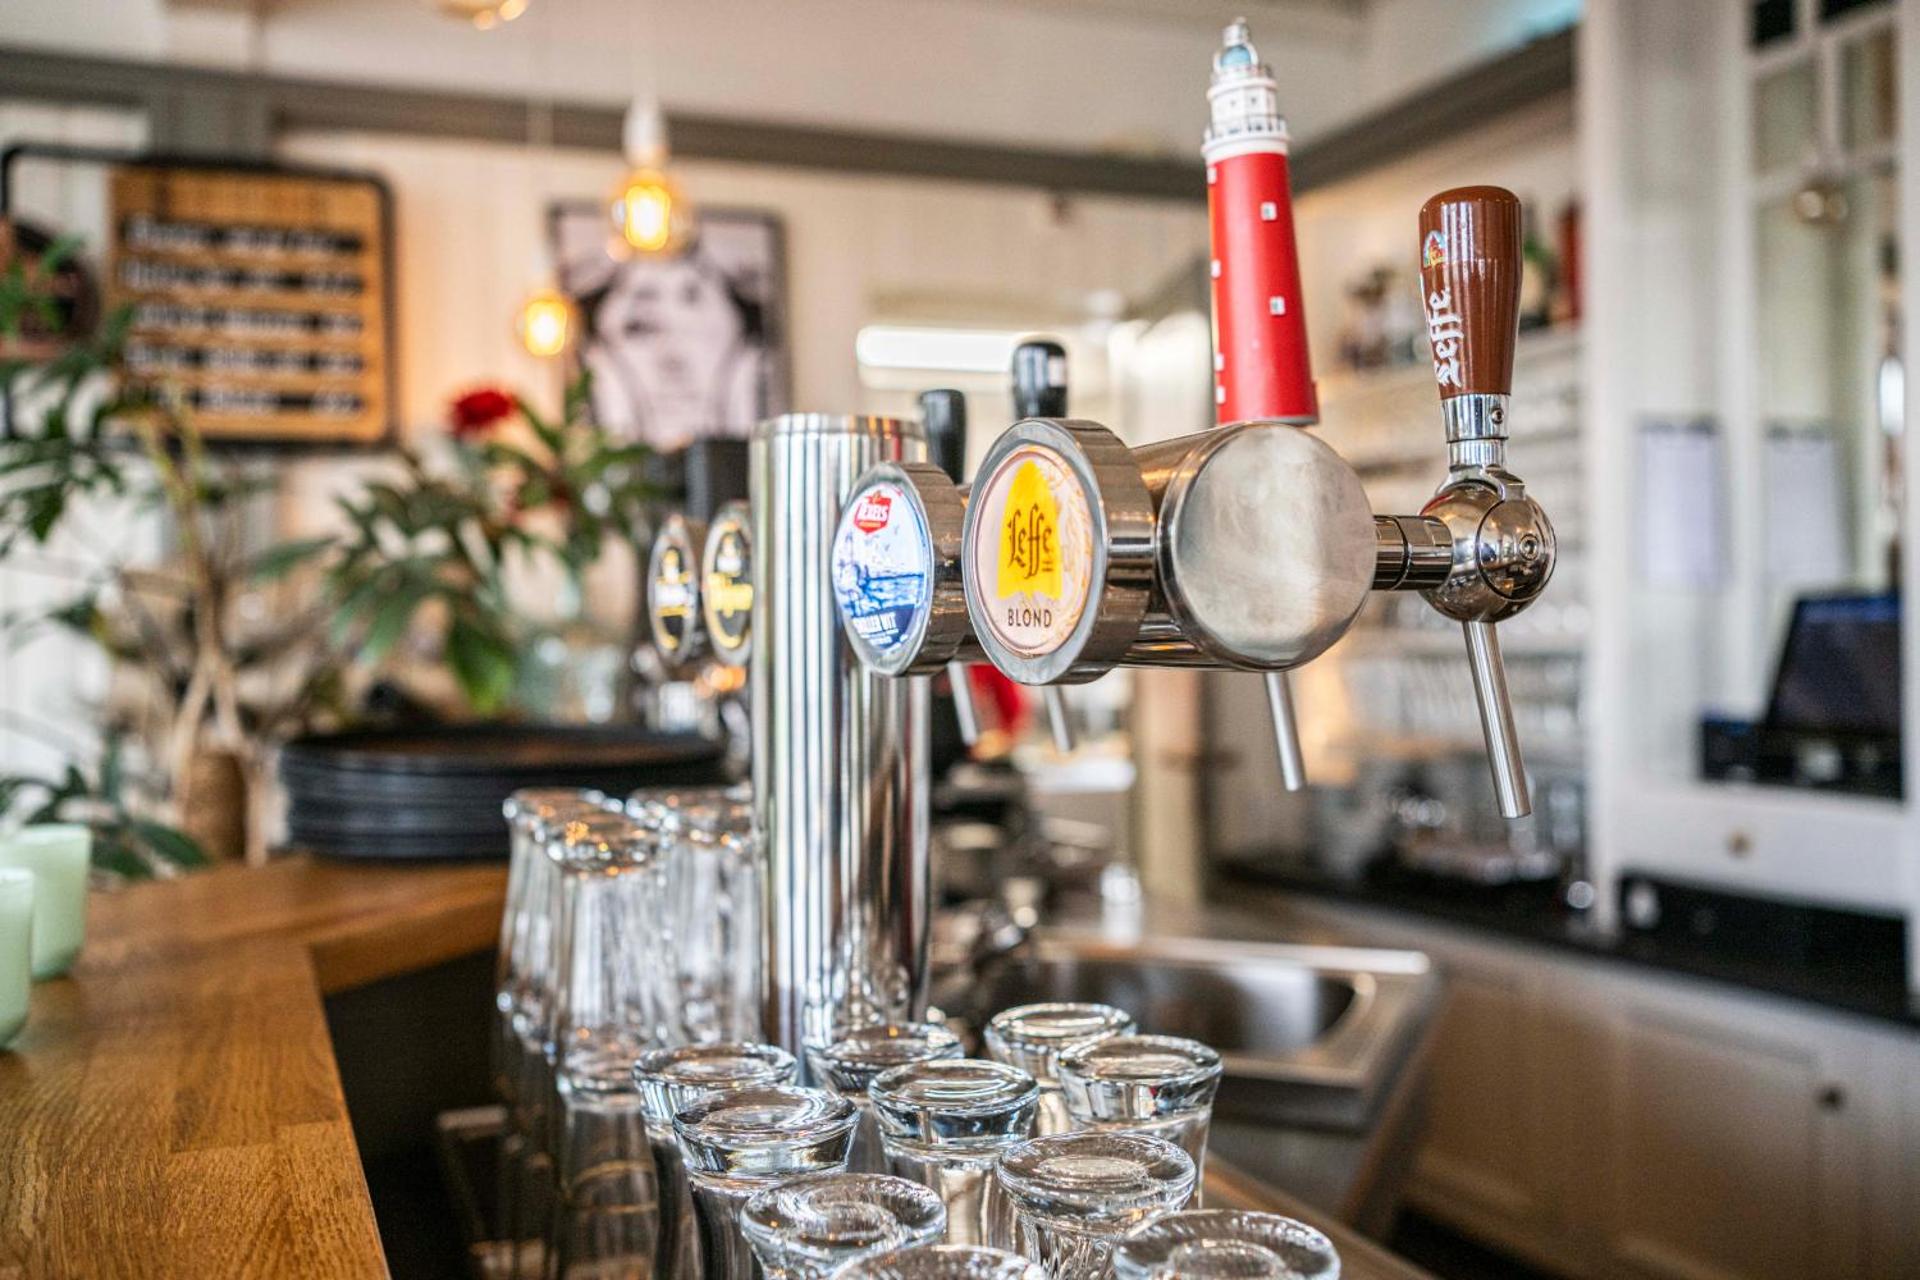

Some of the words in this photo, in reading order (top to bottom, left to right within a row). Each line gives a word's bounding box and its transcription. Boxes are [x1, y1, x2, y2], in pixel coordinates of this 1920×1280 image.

[1428, 286, 1464, 388] Leffe
[1007, 503, 1053, 580] Leffe
[1007, 608, 1053, 628] BLOND
